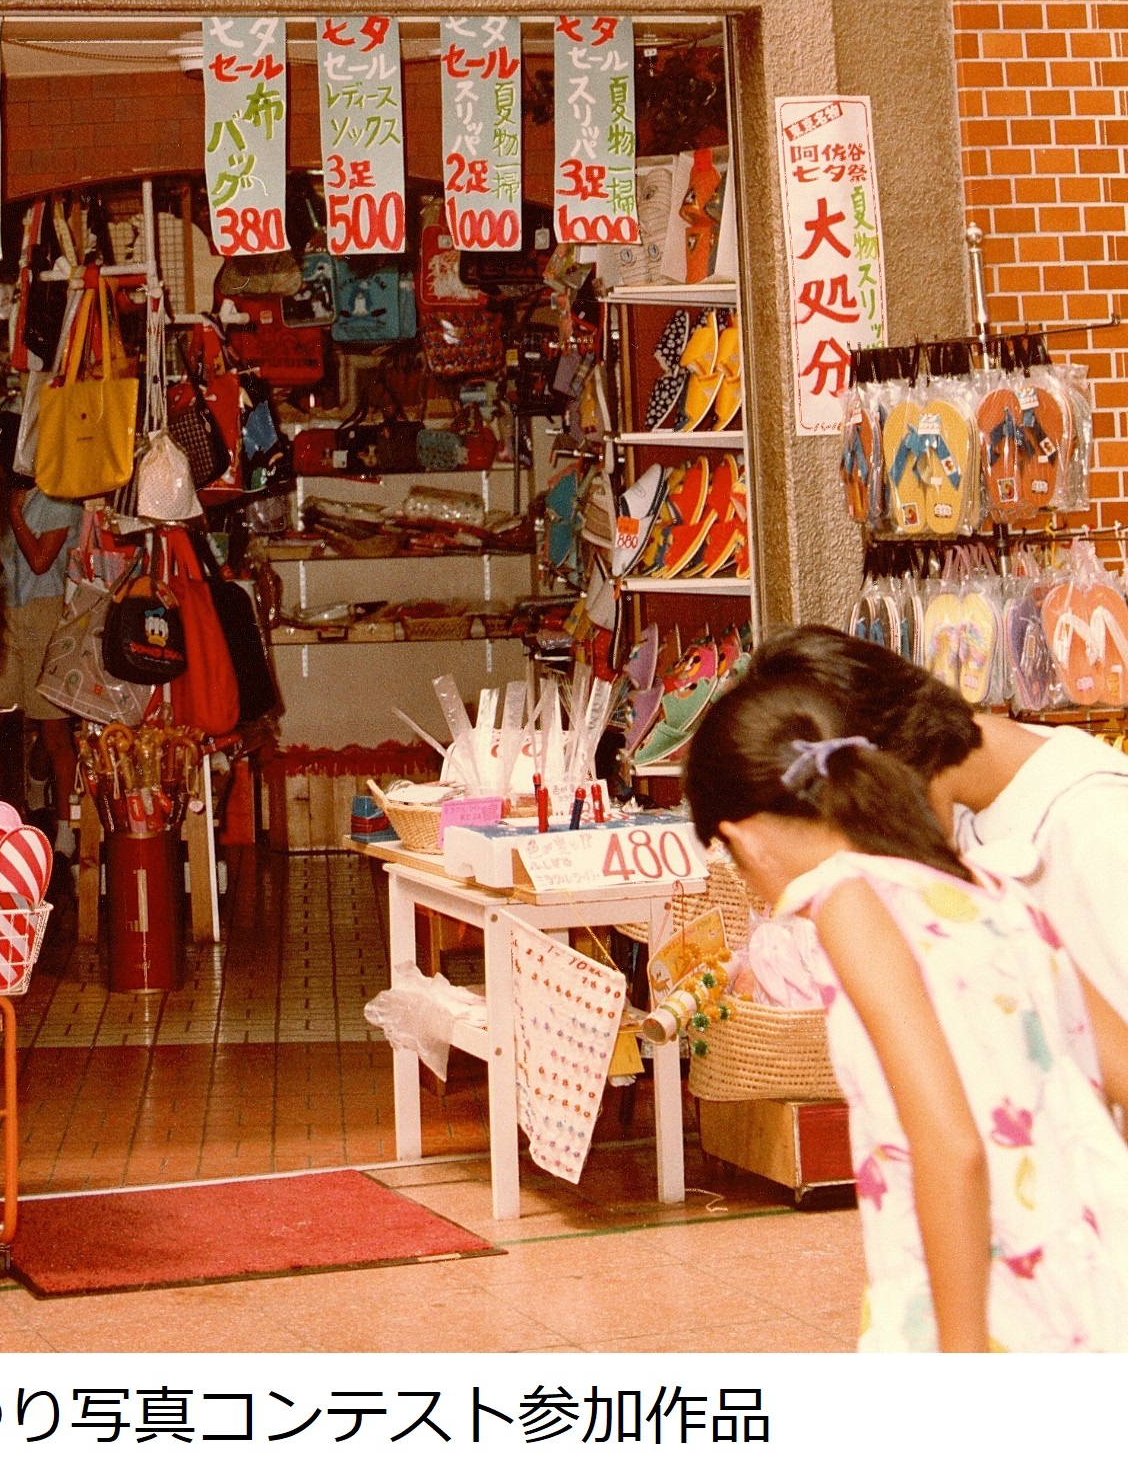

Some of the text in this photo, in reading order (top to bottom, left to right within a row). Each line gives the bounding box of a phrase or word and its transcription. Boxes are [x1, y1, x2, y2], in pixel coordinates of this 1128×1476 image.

[209, 53, 284, 83] セール
[324, 52, 397, 81] セール
[442, 43, 521, 79] セール
[568, 47, 629, 72] セール
[326, 81, 398, 109] レディース
[330, 116, 401, 149] ソックス
[451, 81, 484, 156] スリッパ
[568, 77, 601, 160] スリッパ
[327, 154, 375, 190] 3足
[790, 143, 866, 163] 阿佐谷
[445, 153, 490, 194] 2足
[556, 158, 609, 201] 3足
[792, 164, 868, 184] 七夕祭
[216, 207, 286, 256] 380
[328, 191, 405, 255] 500
[446, 197, 520, 249] 1000
[557, 204, 640, 243] 1000
[850, 185, 886, 349] 夏物スリッ
[793, 197, 860, 398] 大処分
[602, 829, 691, 882] 480
